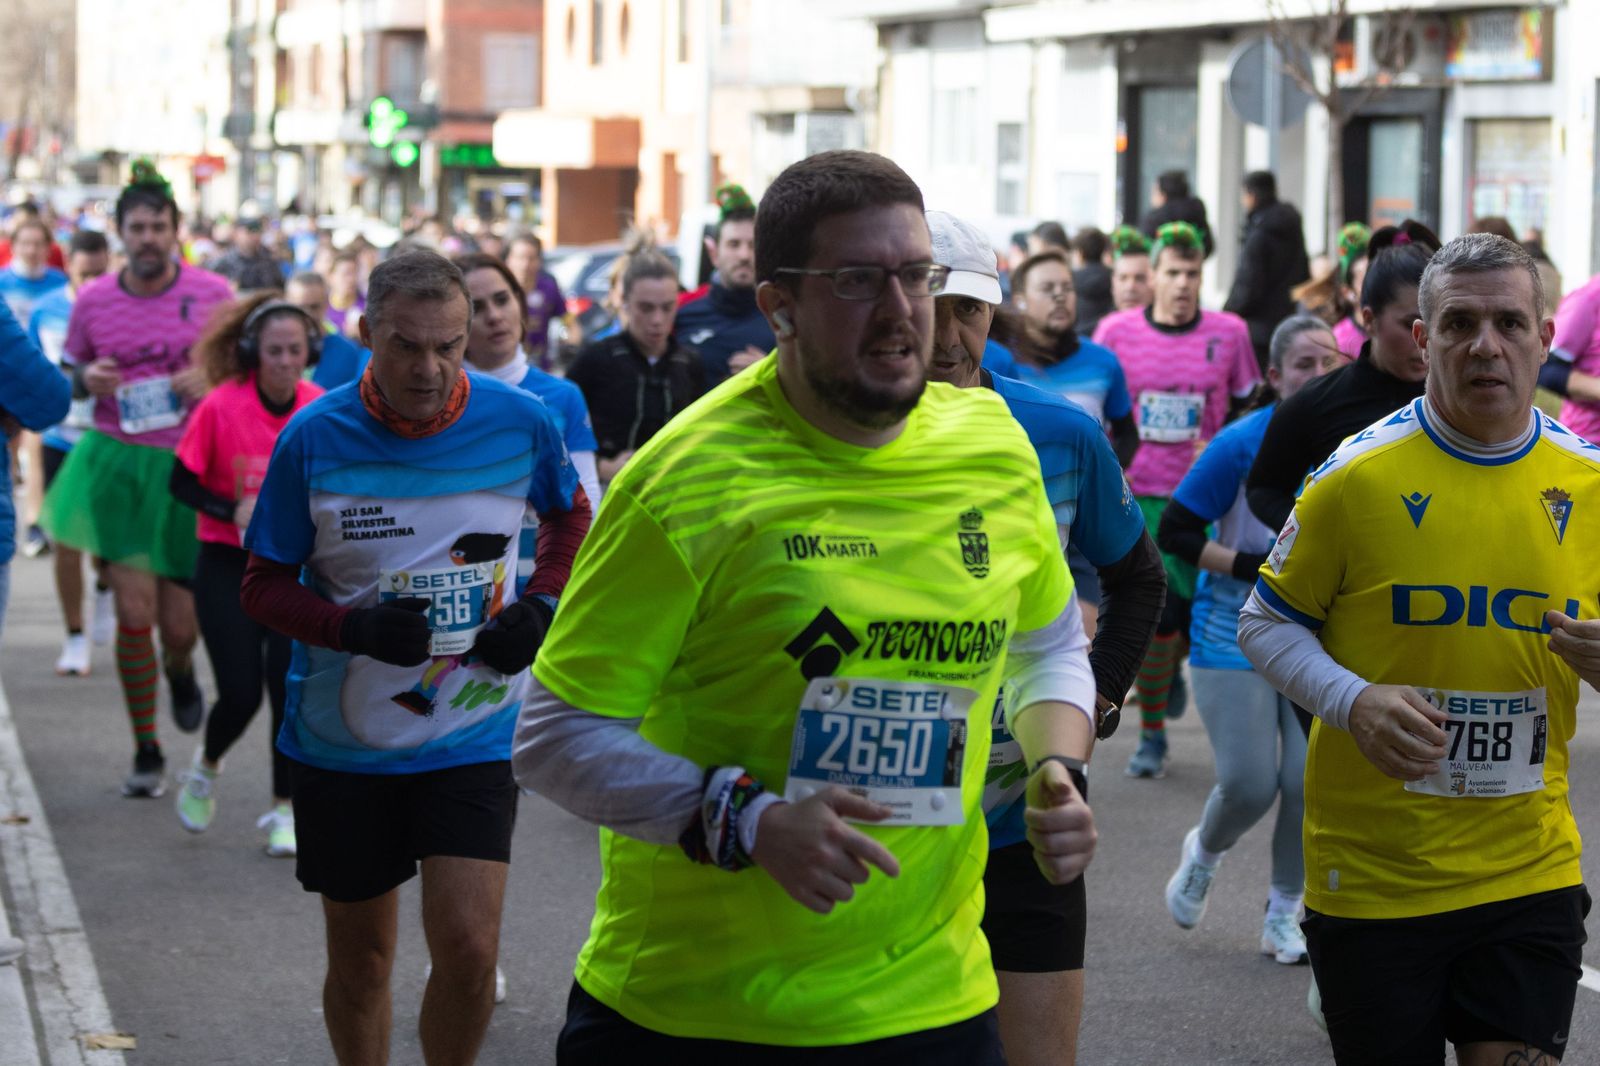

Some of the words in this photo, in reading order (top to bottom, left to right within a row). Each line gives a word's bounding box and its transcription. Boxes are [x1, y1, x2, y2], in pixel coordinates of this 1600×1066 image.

[339, 507, 358, 518] XLI
[360, 505, 383, 517] SAN
[341, 516, 396, 530] SILVESTRE
[342, 526, 416, 541] SALMANTINA
[782, 533, 826, 562] 10K
[826, 542, 879, 559] MARTA
[412, 568, 485, 590] SETEL
[1447, 696, 1537, 716] SETEL
[815, 713, 934, 778] 2650
[1467, 779, 1508, 788] Ayuntamiento
[1476, 786, 1507, 795] Salamanca
